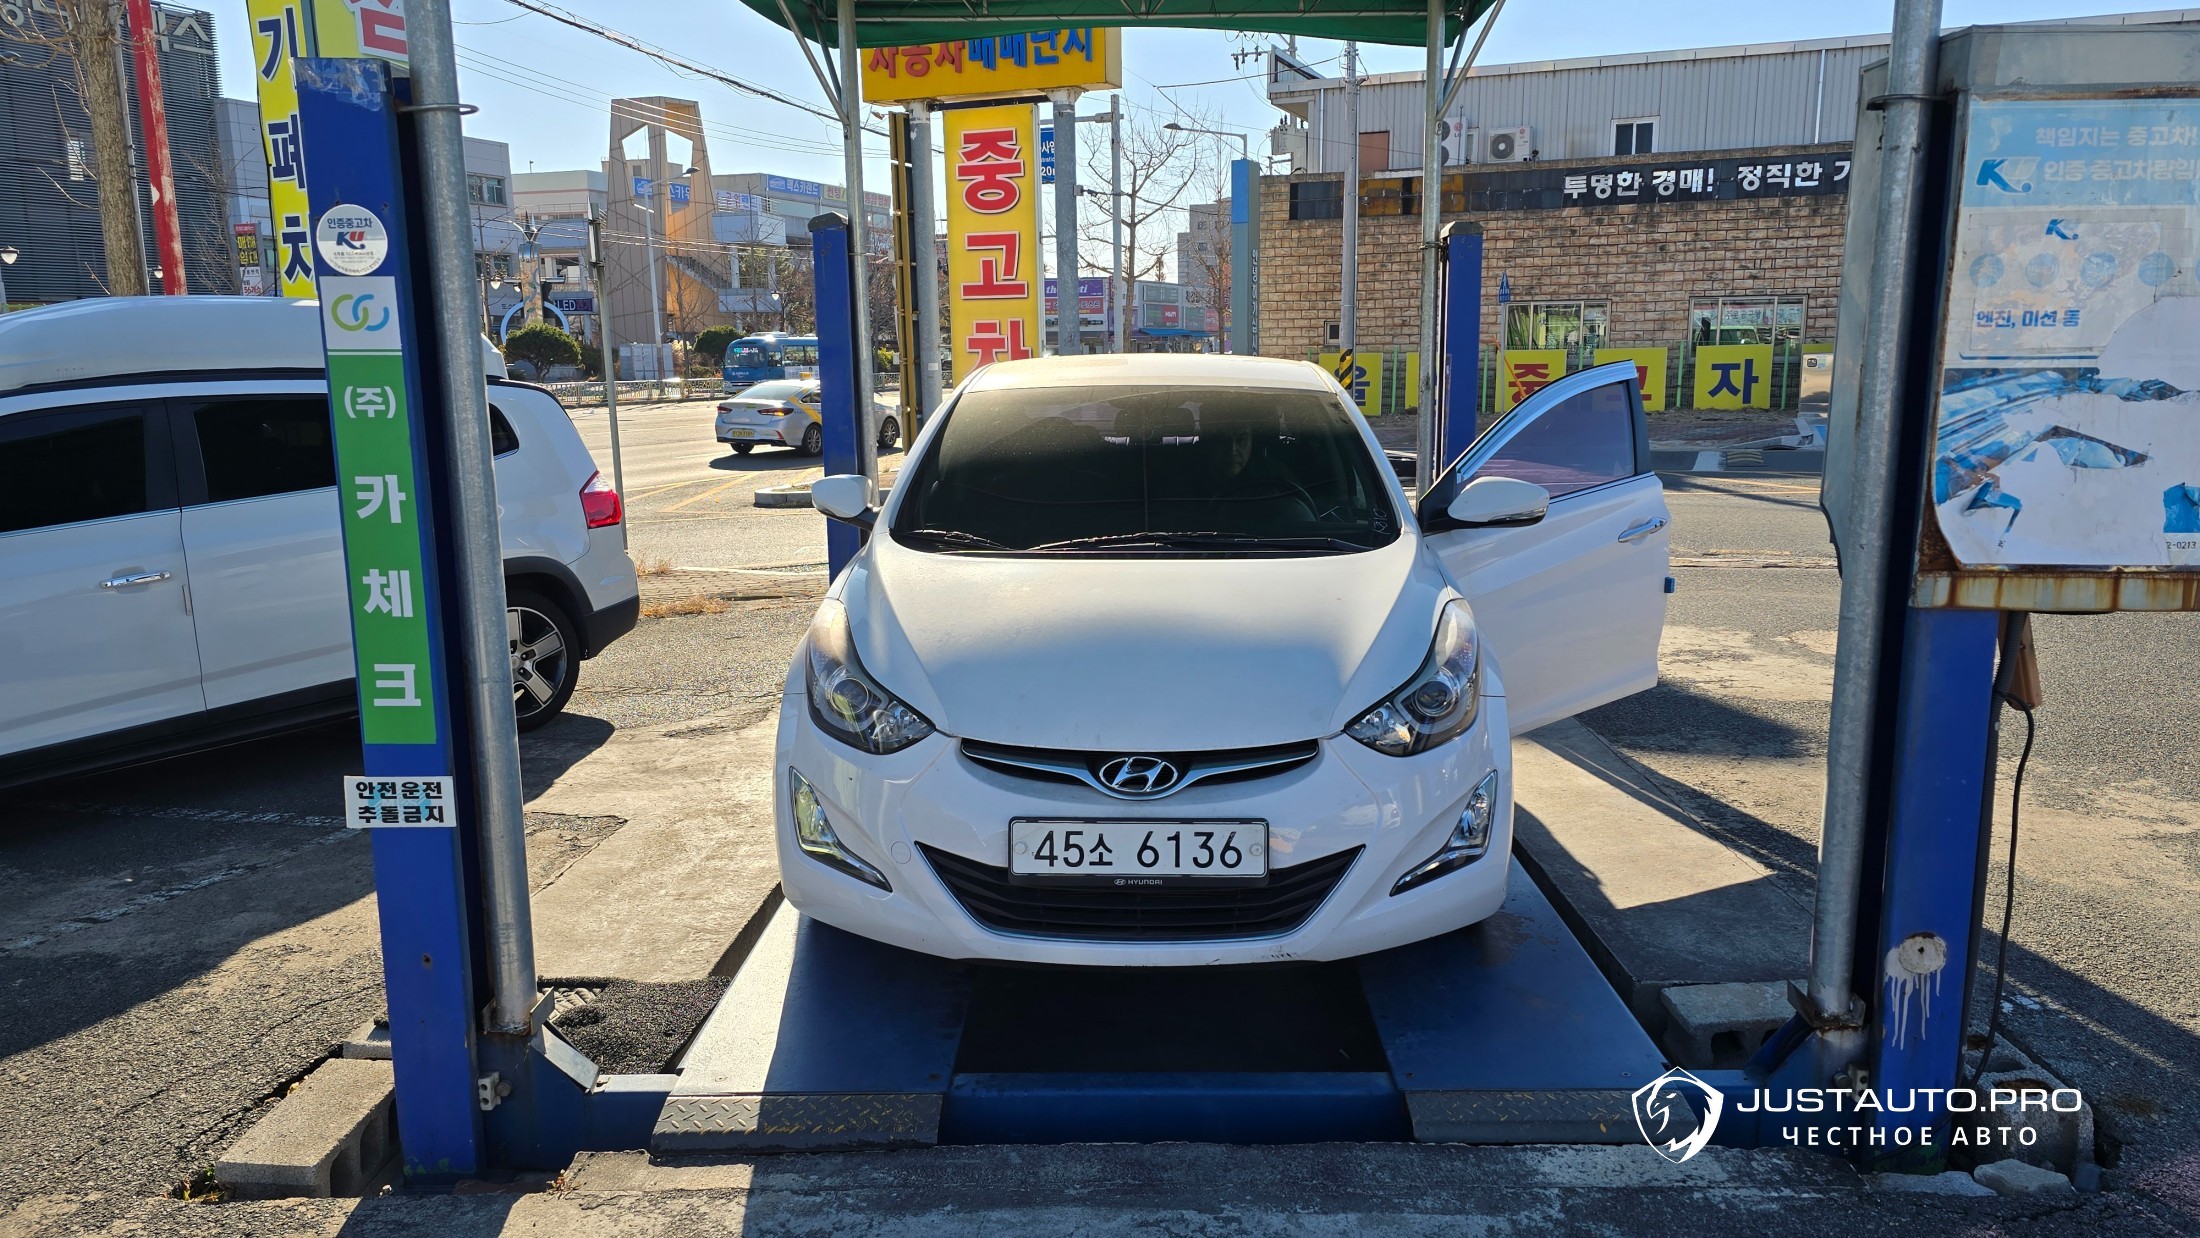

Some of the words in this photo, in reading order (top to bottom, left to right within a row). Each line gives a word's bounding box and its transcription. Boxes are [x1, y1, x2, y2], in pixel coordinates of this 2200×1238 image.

[2035, 126, 2120, 147] 책임지는
[1563, 170, 1643, 199] 투명한
[1652, 167, 1715, 196] 경매!
[1737, 161, 1823, 191] 정직한
[2090, 159, 2200, 182] 중고차량임
[326, 217, 373, 229] 인증중고차
[1976, 309, 2017, 329] 엔진,
[1711, 358, 1761, 405] 자
[343, 386, 397, 419] (주)
[355, 780, 443, 800] 안전운전
[357, 803, 445, 825] 추돌금지
[1034, 830, 1113, 868] 45소
[1136, 830, 1243, 869] 6136
